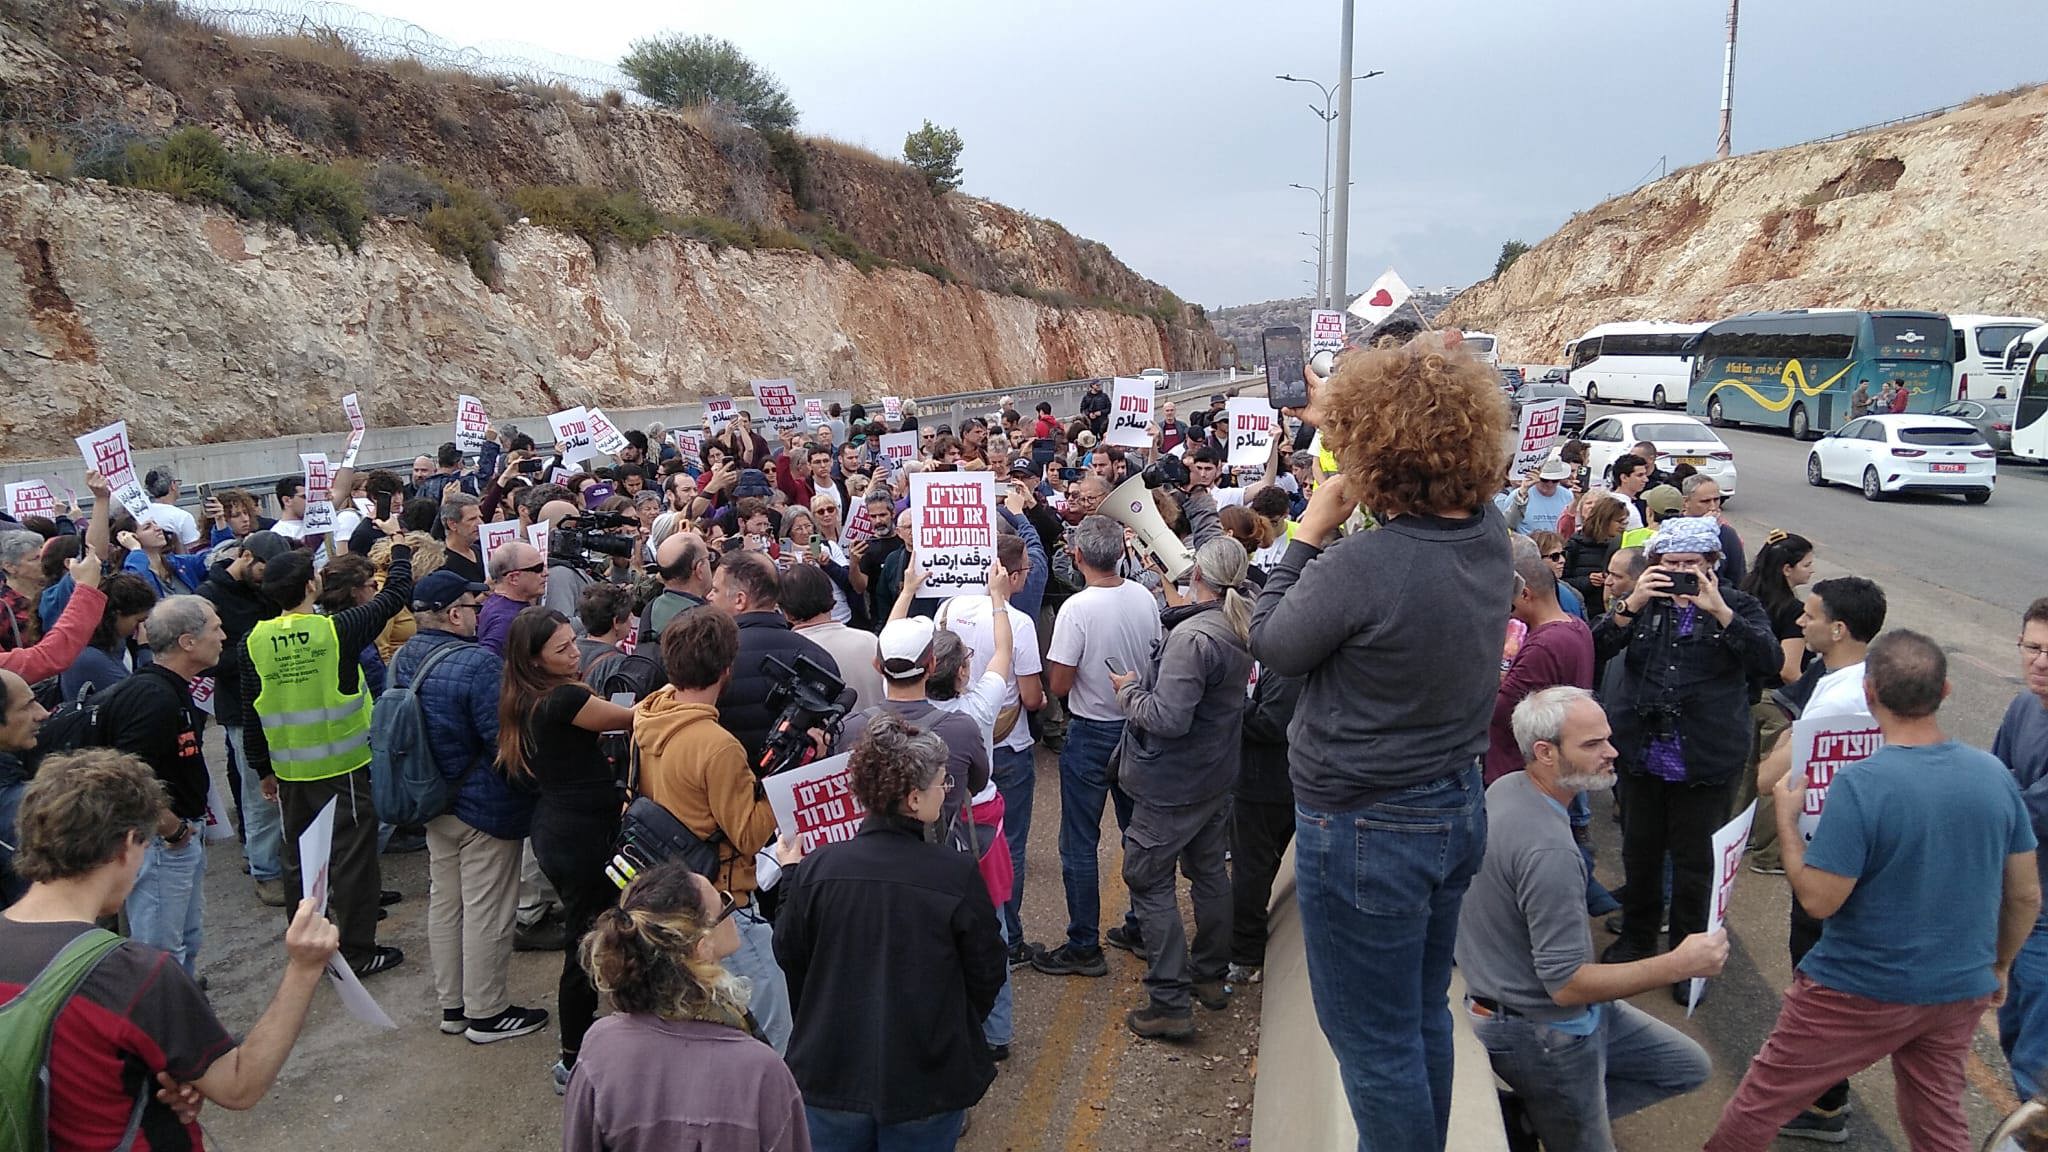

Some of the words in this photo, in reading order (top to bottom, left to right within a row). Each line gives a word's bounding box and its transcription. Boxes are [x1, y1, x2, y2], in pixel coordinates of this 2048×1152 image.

[709, 401, 731, 411] שלום
[1119, 395, 1149, 413] שלום
[559, 421, 586, 437] שלום
[1115, 414, 1148, 430] سلام
[1237, 413, 1269, 431] שלום
[566, 436, 589, 452] سلام
[1236, 432, 1268, 450] سلام
[887, 445, 912, 458] שלום
[931, 486, 978, 505] עוצרים
[925, 507, 959, 525] טרור
[963, 507, 983, 525] את
[923, 524, 989, 546] המתנחלים
[922, 553, 958, 571] إرهاب
[959, 547, 992, 570] نوقف
[926, 571, 989, 588] المستوطنين
[271, 632, 309, 653] סדרן
[798, 798, 846, 828] טרור
